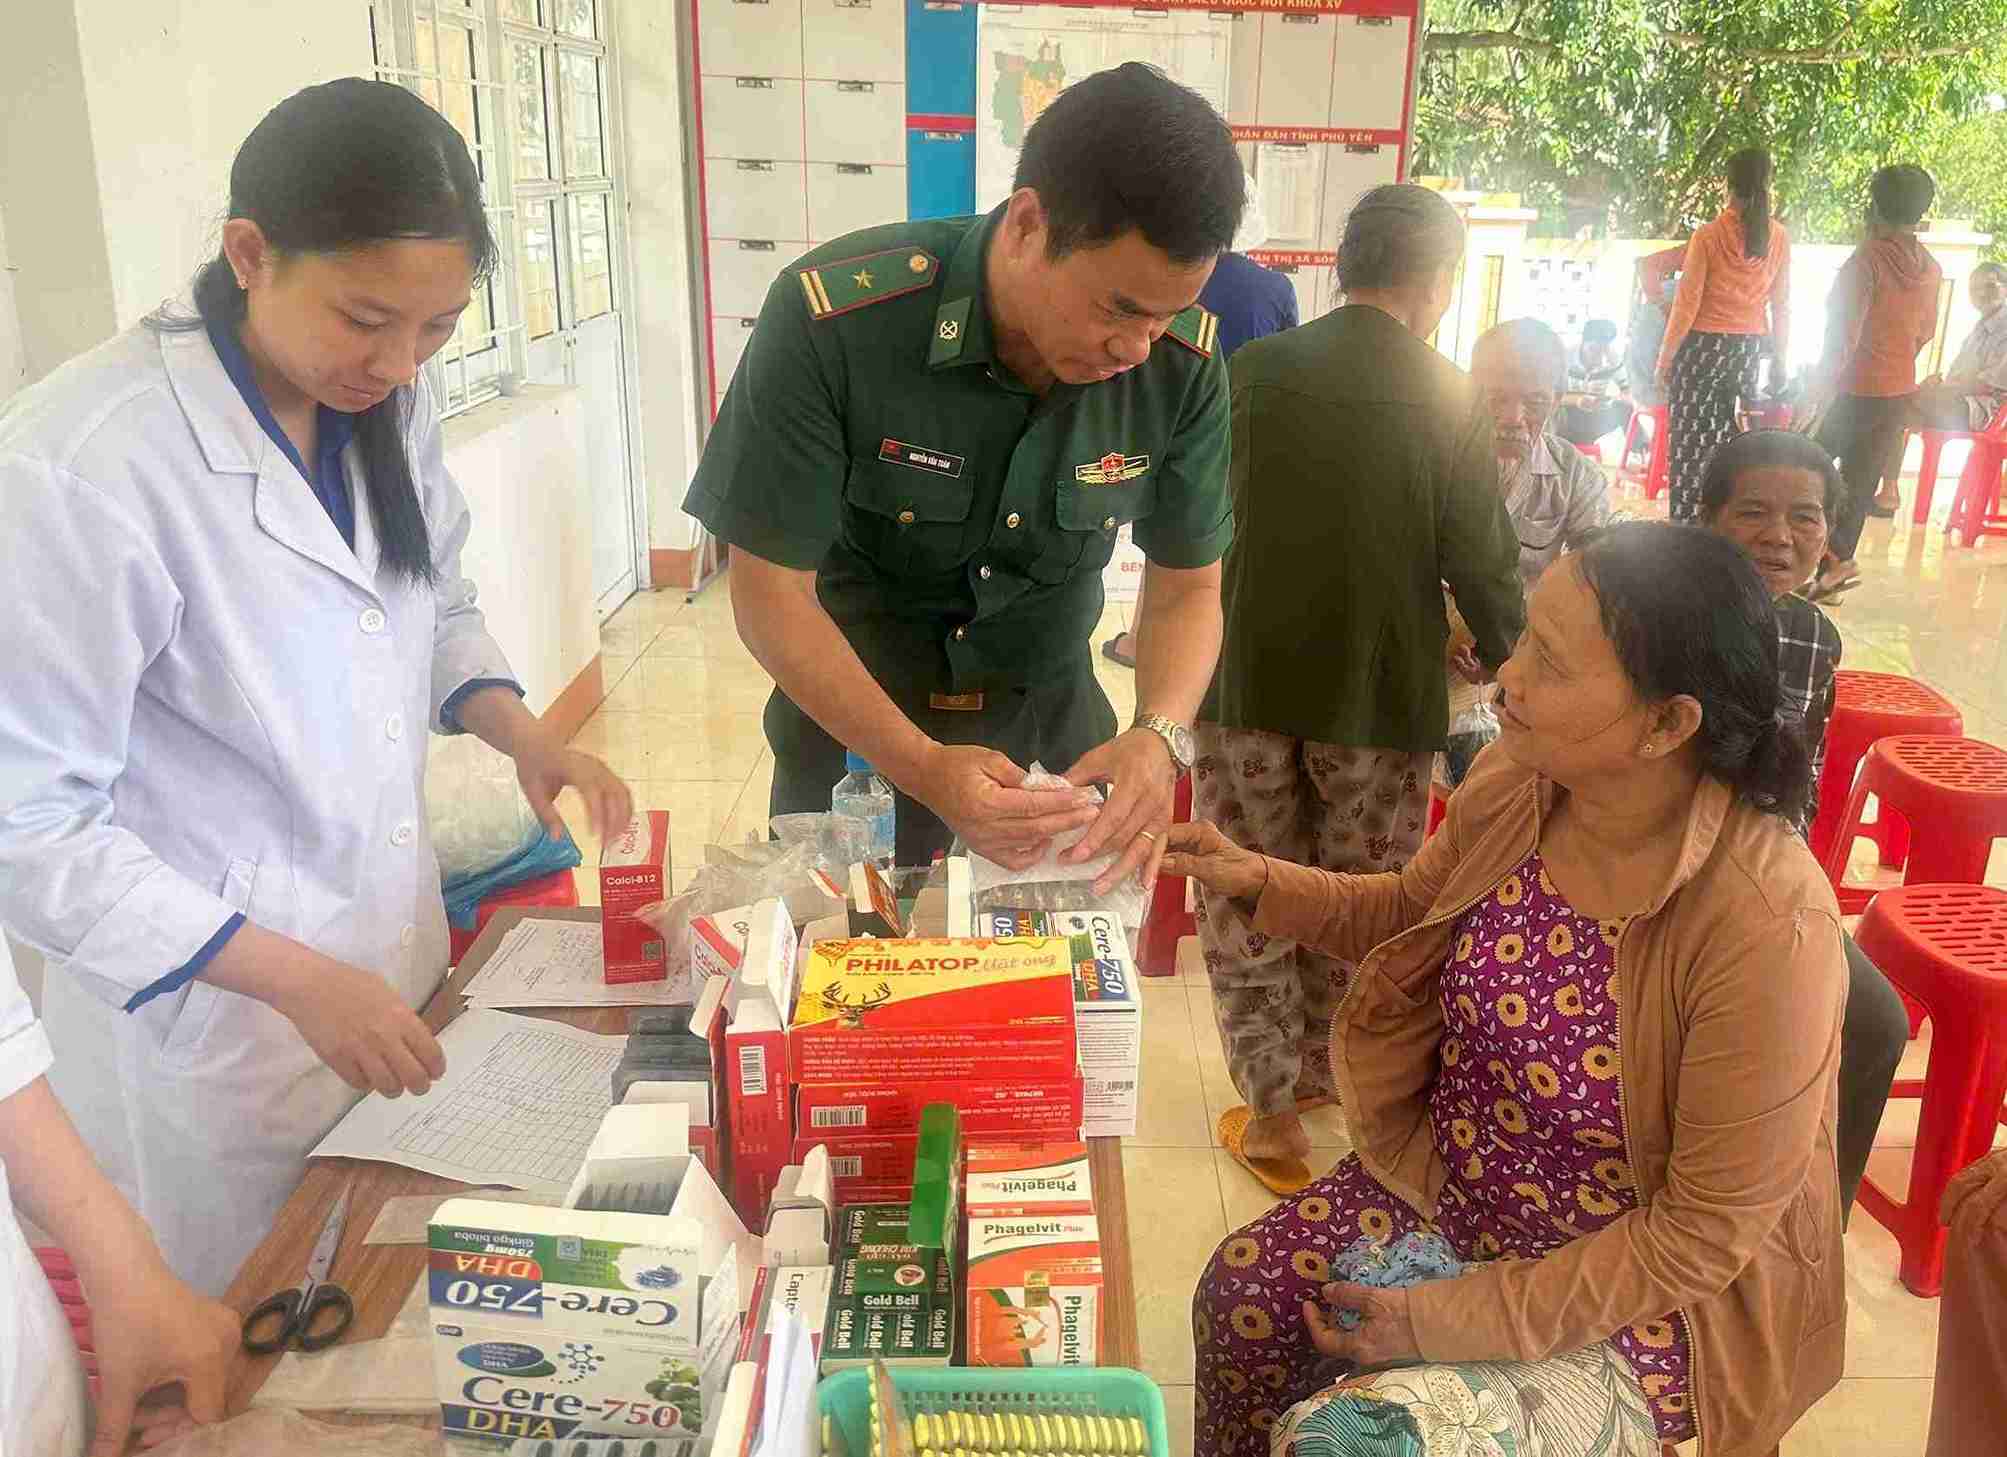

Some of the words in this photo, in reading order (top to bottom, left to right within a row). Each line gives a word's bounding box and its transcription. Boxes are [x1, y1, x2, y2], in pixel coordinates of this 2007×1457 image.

[846, 957, 979, 972] PHILATOP
[1003, 1180, 1077, 1193] Phagelvit
[983, 1223, 1062, 1237] Phagelvit
[455, 1254, 533, 1278] DHA
[446, 1279, 679, 1326] Cere-750
[864, 1295, 893, 1306] Gold
[896, 1294, 919, 1306] Bell
[839, 1309, 853, 1330] Gold
[871, 1312, 884, 1330] old
[902, 1313, 915, 1328] old
[934, 1308, 947, 1328] Gold
[838, 1331, 851, 1349] Bell
[869, 1331, 883, 1349] Bell
[901, 1329, 914, 1348] Bell
[932, 1329, 945, 1348] Bell
[1063, 1295, 1081, 1367] Phagelvit
[462, 1376, 682, 1429] Cere-750
[466, 1408, 557, 1440] DHA
